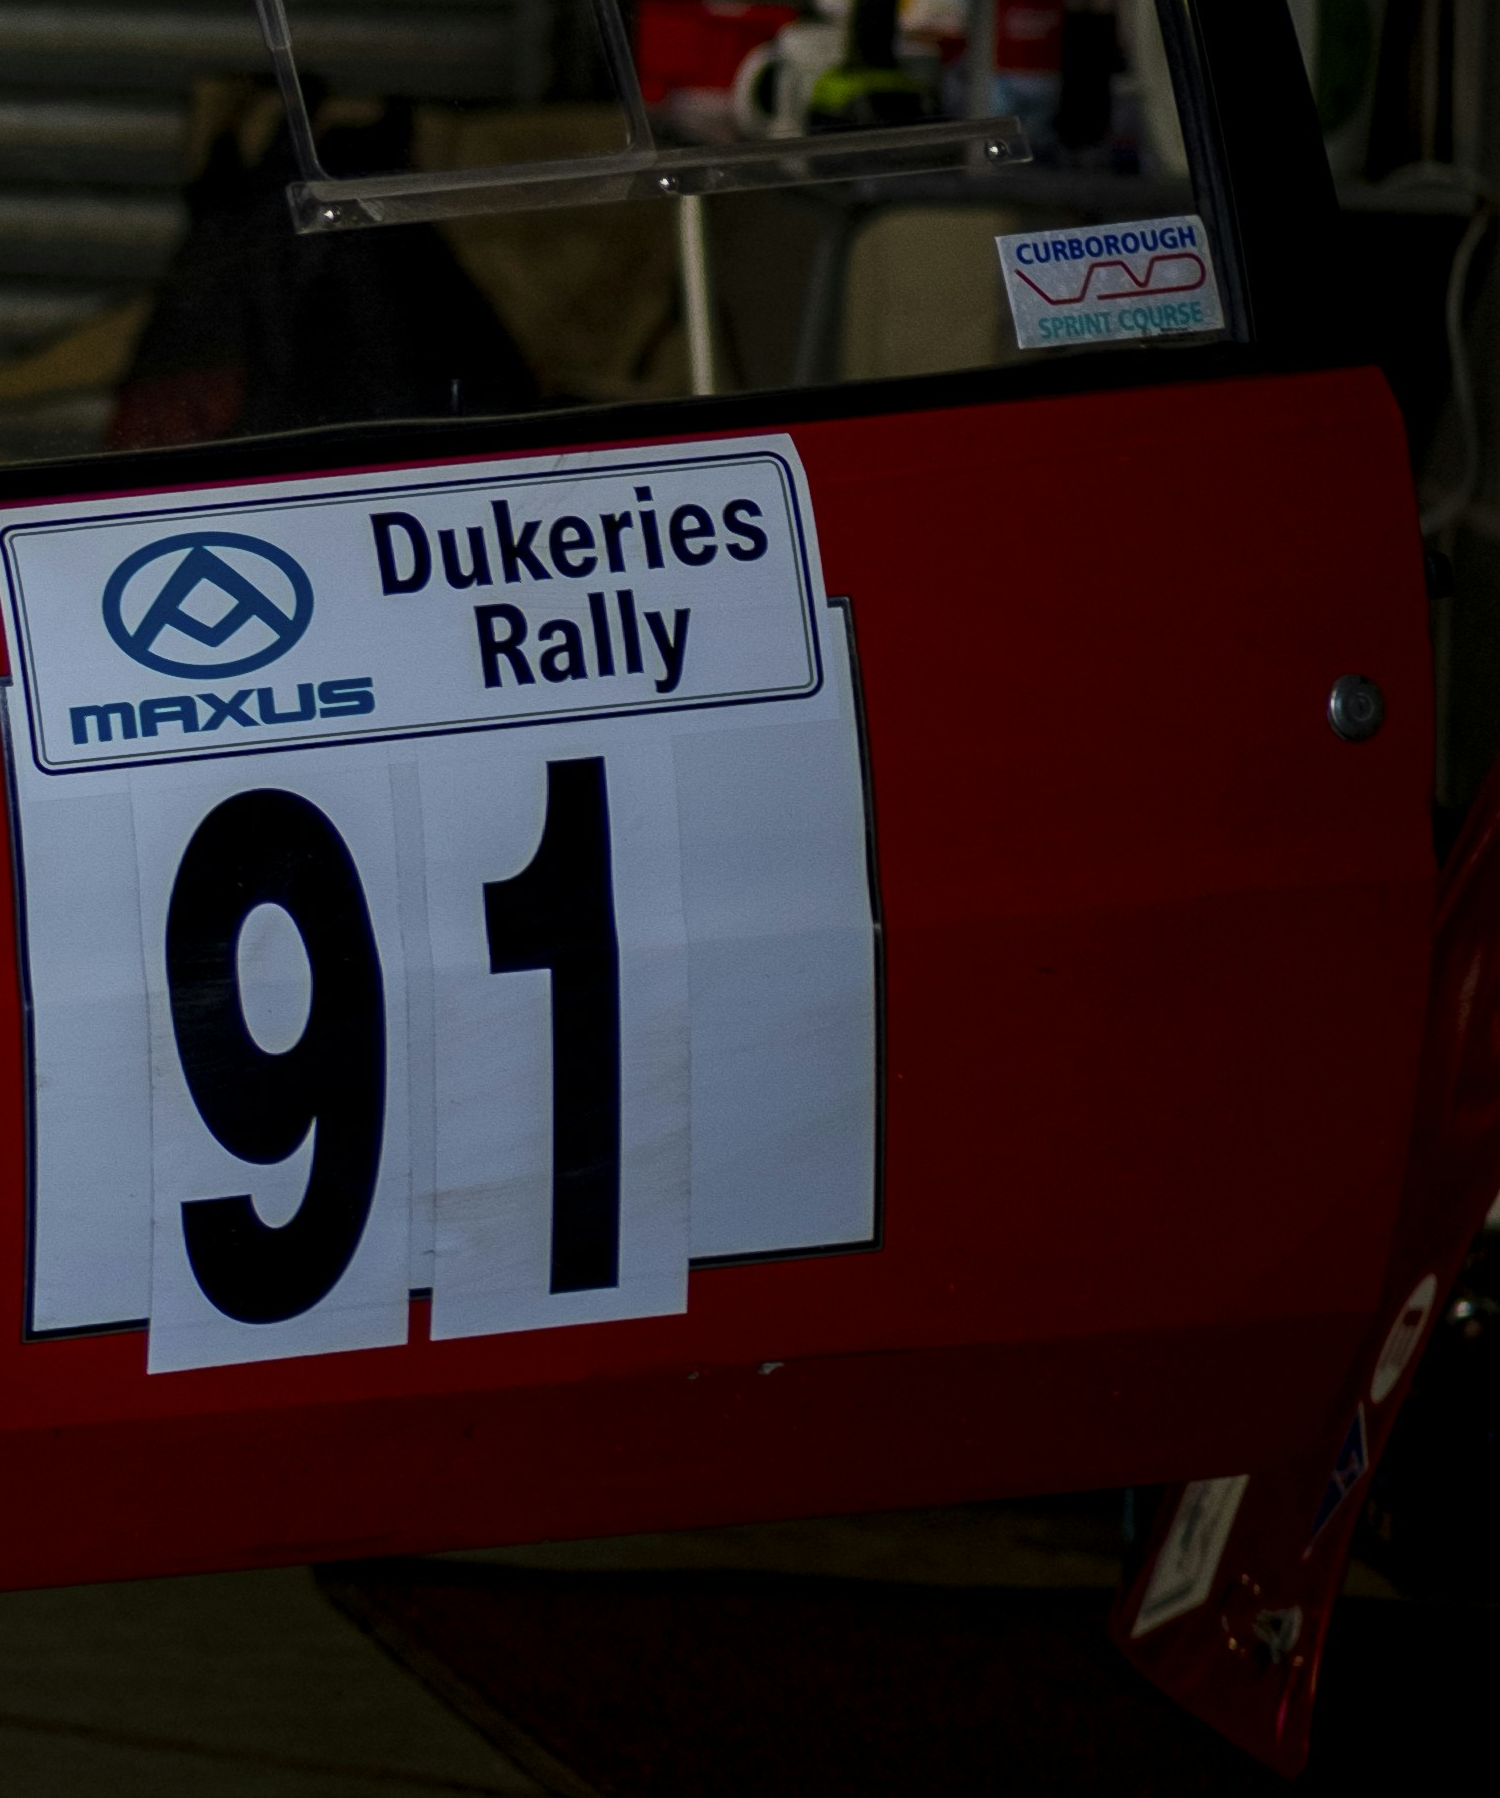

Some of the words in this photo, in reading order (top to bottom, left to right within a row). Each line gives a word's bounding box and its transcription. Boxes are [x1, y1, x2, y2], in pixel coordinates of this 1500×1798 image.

[1016, 226, 1196, 265] CURBOROUGH
[1038, 311, 1113, 340] SPRINT
[1118, 302, 1203, 332] COURSE
[370, 486, 768, 596] Dukeries
[475, 590, 691, 693] Rally
[69, 677, 375, 745] MAXUS
[165, 756, 622, 1324] 91
